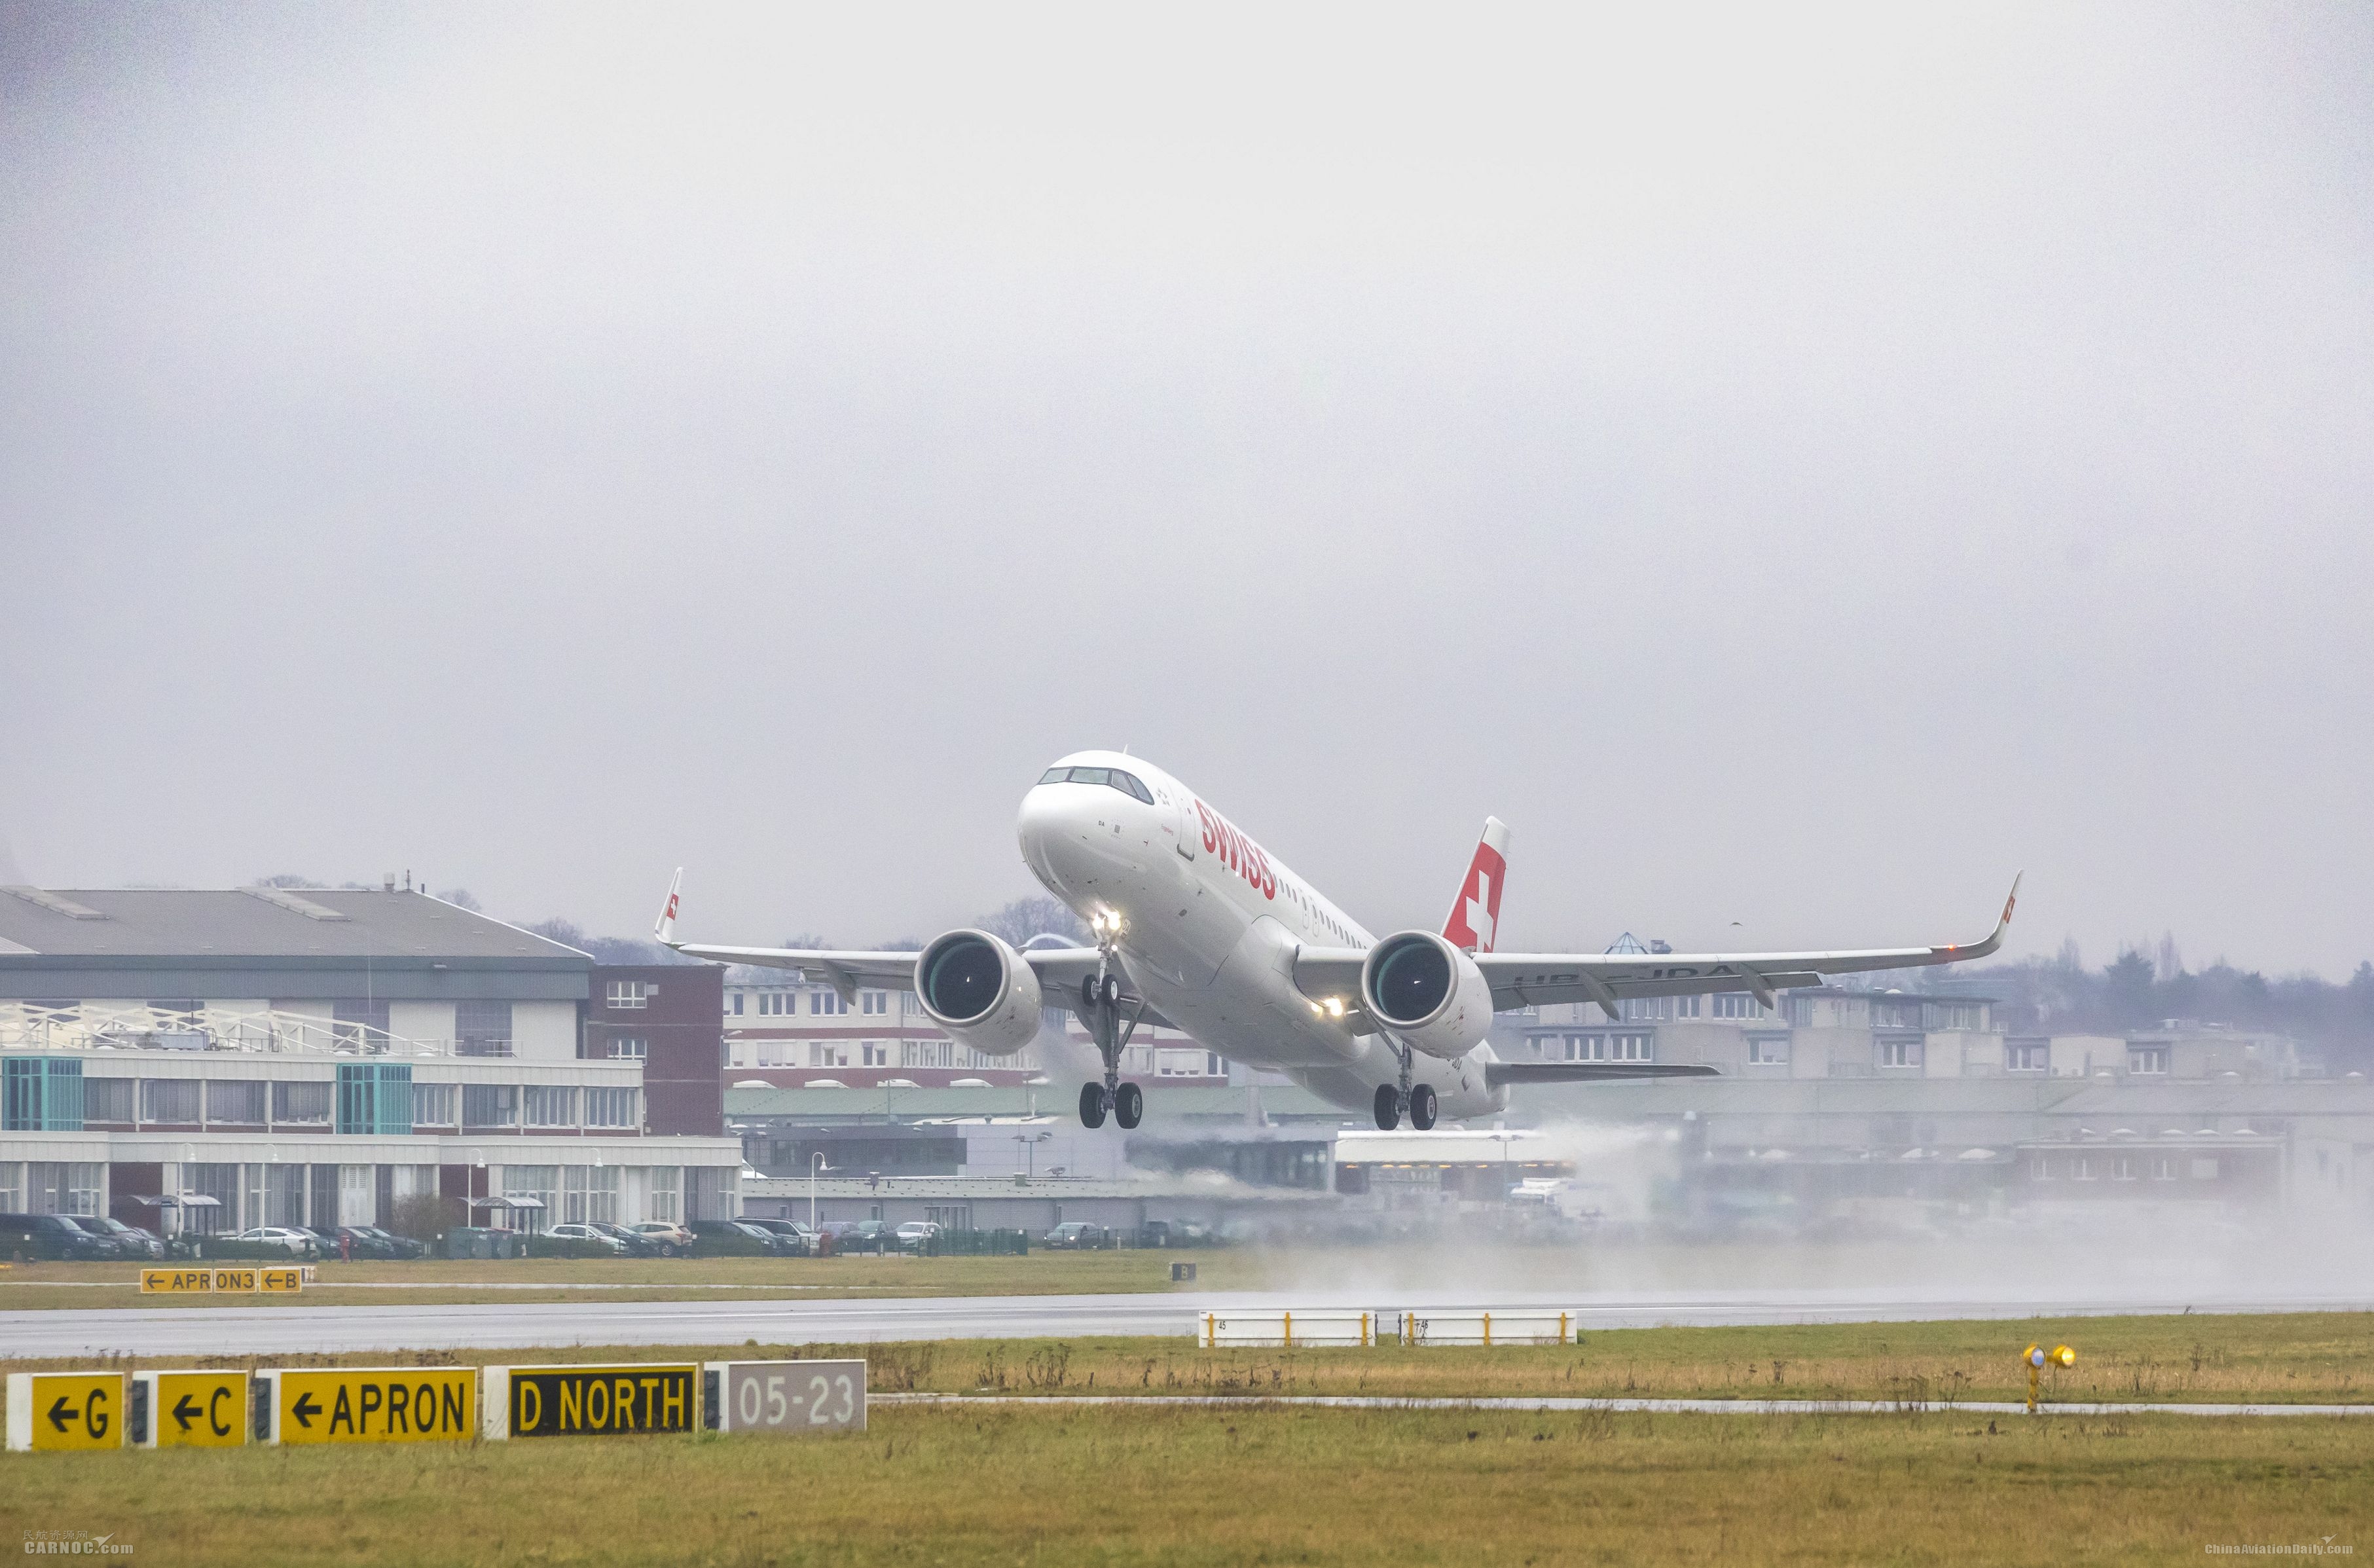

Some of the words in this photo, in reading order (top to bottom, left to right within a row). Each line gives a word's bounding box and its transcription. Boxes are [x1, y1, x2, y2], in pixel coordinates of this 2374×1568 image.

[1195, 799, 1275, 900] SWISS
[285, 1273, 297, 1288] B
[1219, 1321, 1226, 1330] 45
[86, 1389, 108, 1439] G
[210, 1386, 231, 1436] C
[329, 1381, 464, 1434] APRON
[520, 1381, 541, 1431] D
[560, 1378, 684, 1430] NORTH
[739, 1375, 854, 1425] 05-23
